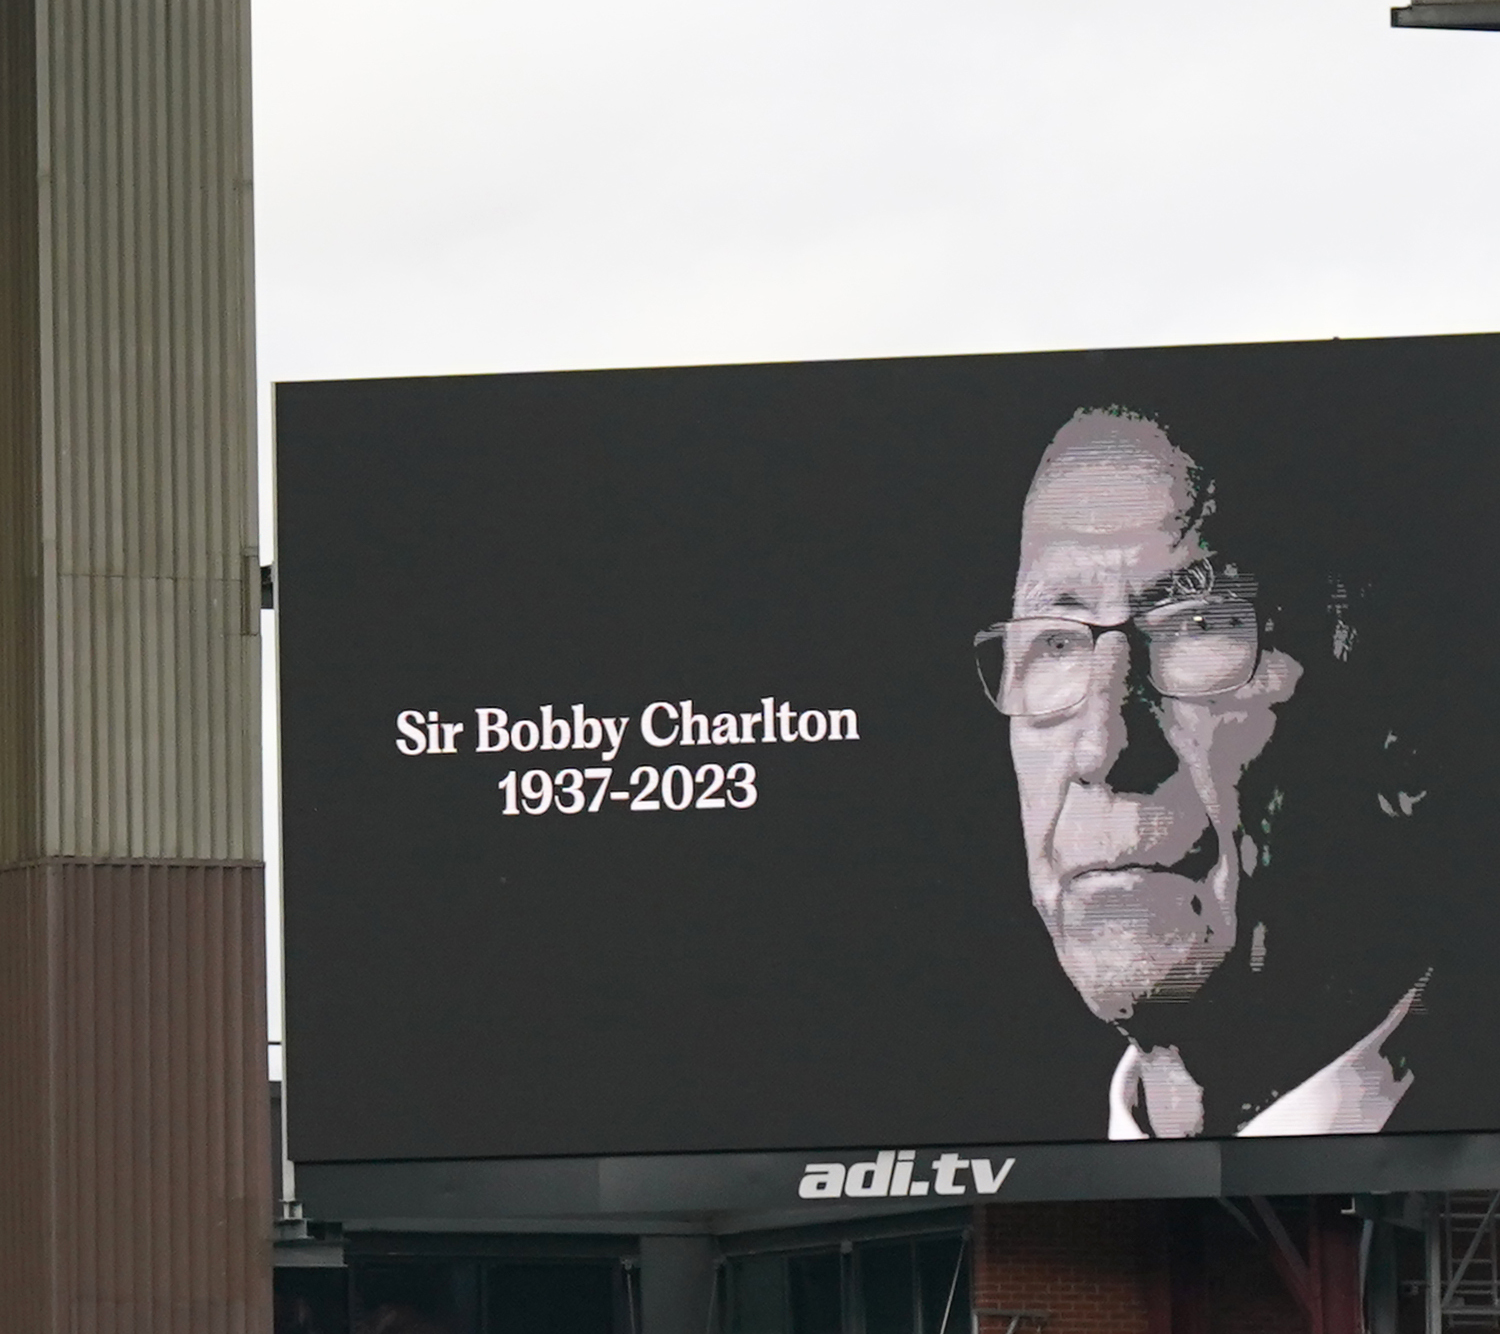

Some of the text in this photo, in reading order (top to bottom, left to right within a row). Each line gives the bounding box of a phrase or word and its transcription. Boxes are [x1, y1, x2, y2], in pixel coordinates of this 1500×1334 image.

[395, 697, 861, 761] Sir Bobby Charlton
[498, 763, 758, 816] 1937-2023
[799, 1150, 1015, 1199] adi.tv
